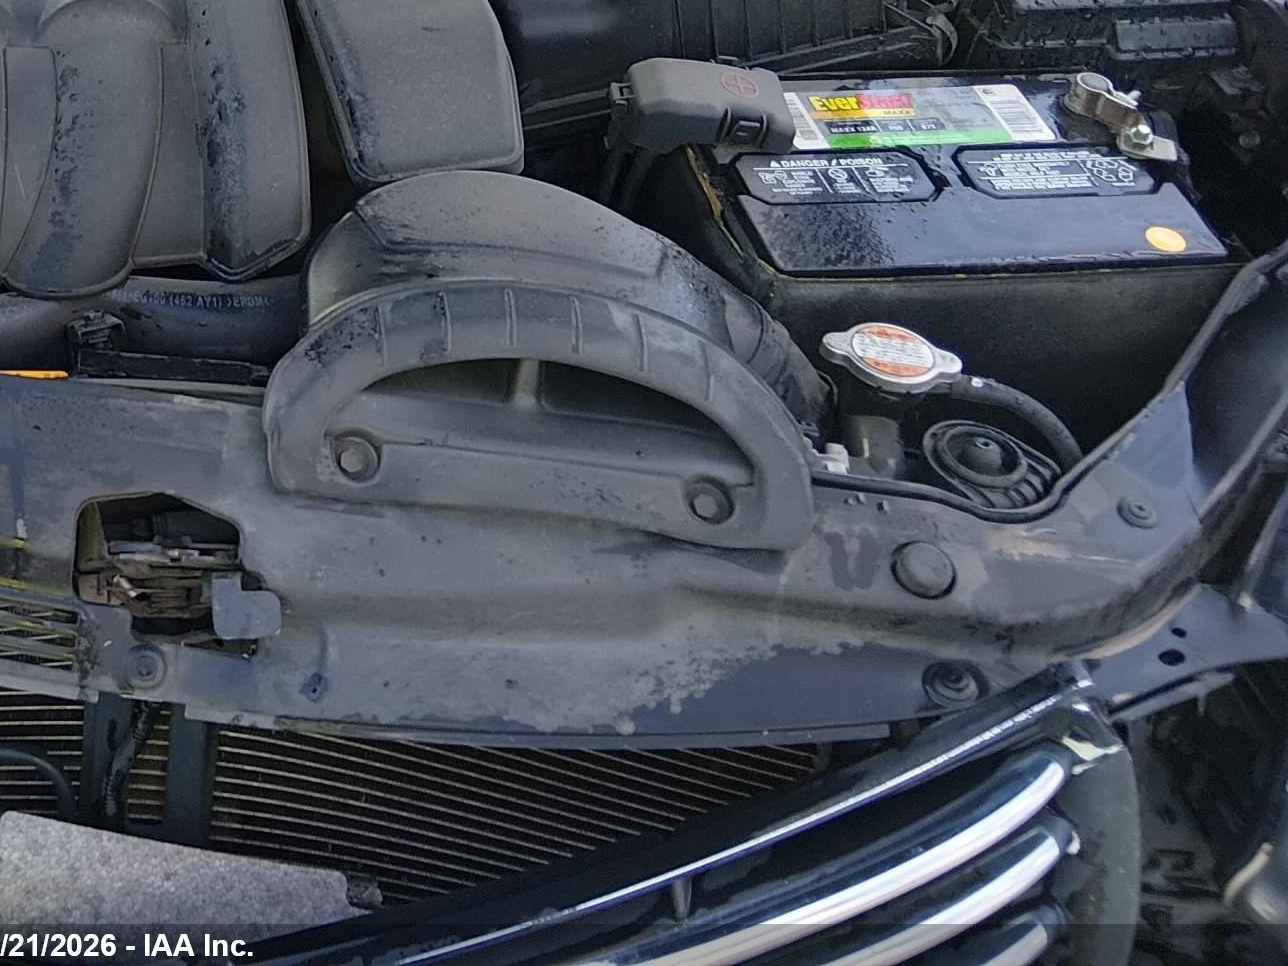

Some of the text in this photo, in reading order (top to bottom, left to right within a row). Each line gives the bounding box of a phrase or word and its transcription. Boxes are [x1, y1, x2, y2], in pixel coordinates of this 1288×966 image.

[808, 93, 913, 112] EverStart
[782, 159, 829, 168] DANGER
[839, 158, 883, 166] POISON
